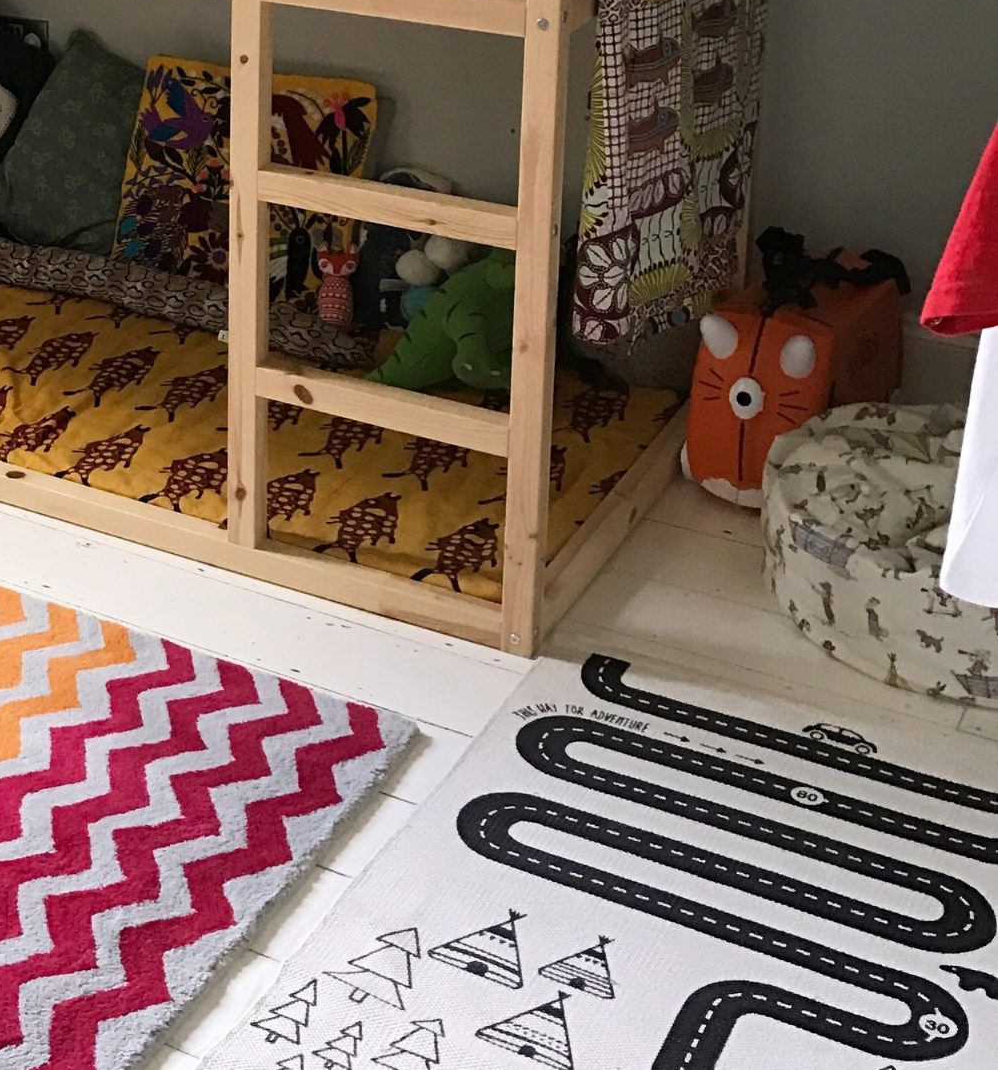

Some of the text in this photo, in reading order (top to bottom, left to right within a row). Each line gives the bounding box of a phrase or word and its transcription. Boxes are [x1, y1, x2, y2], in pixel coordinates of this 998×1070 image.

[512, 706, 537, 720] THIS
[536, 703, 557, 713] WAY
[590, 709, 650, 733] ADVENTURE
[797, 790, 818, 802] 80
[925, 1020, 950, 1034] 30
